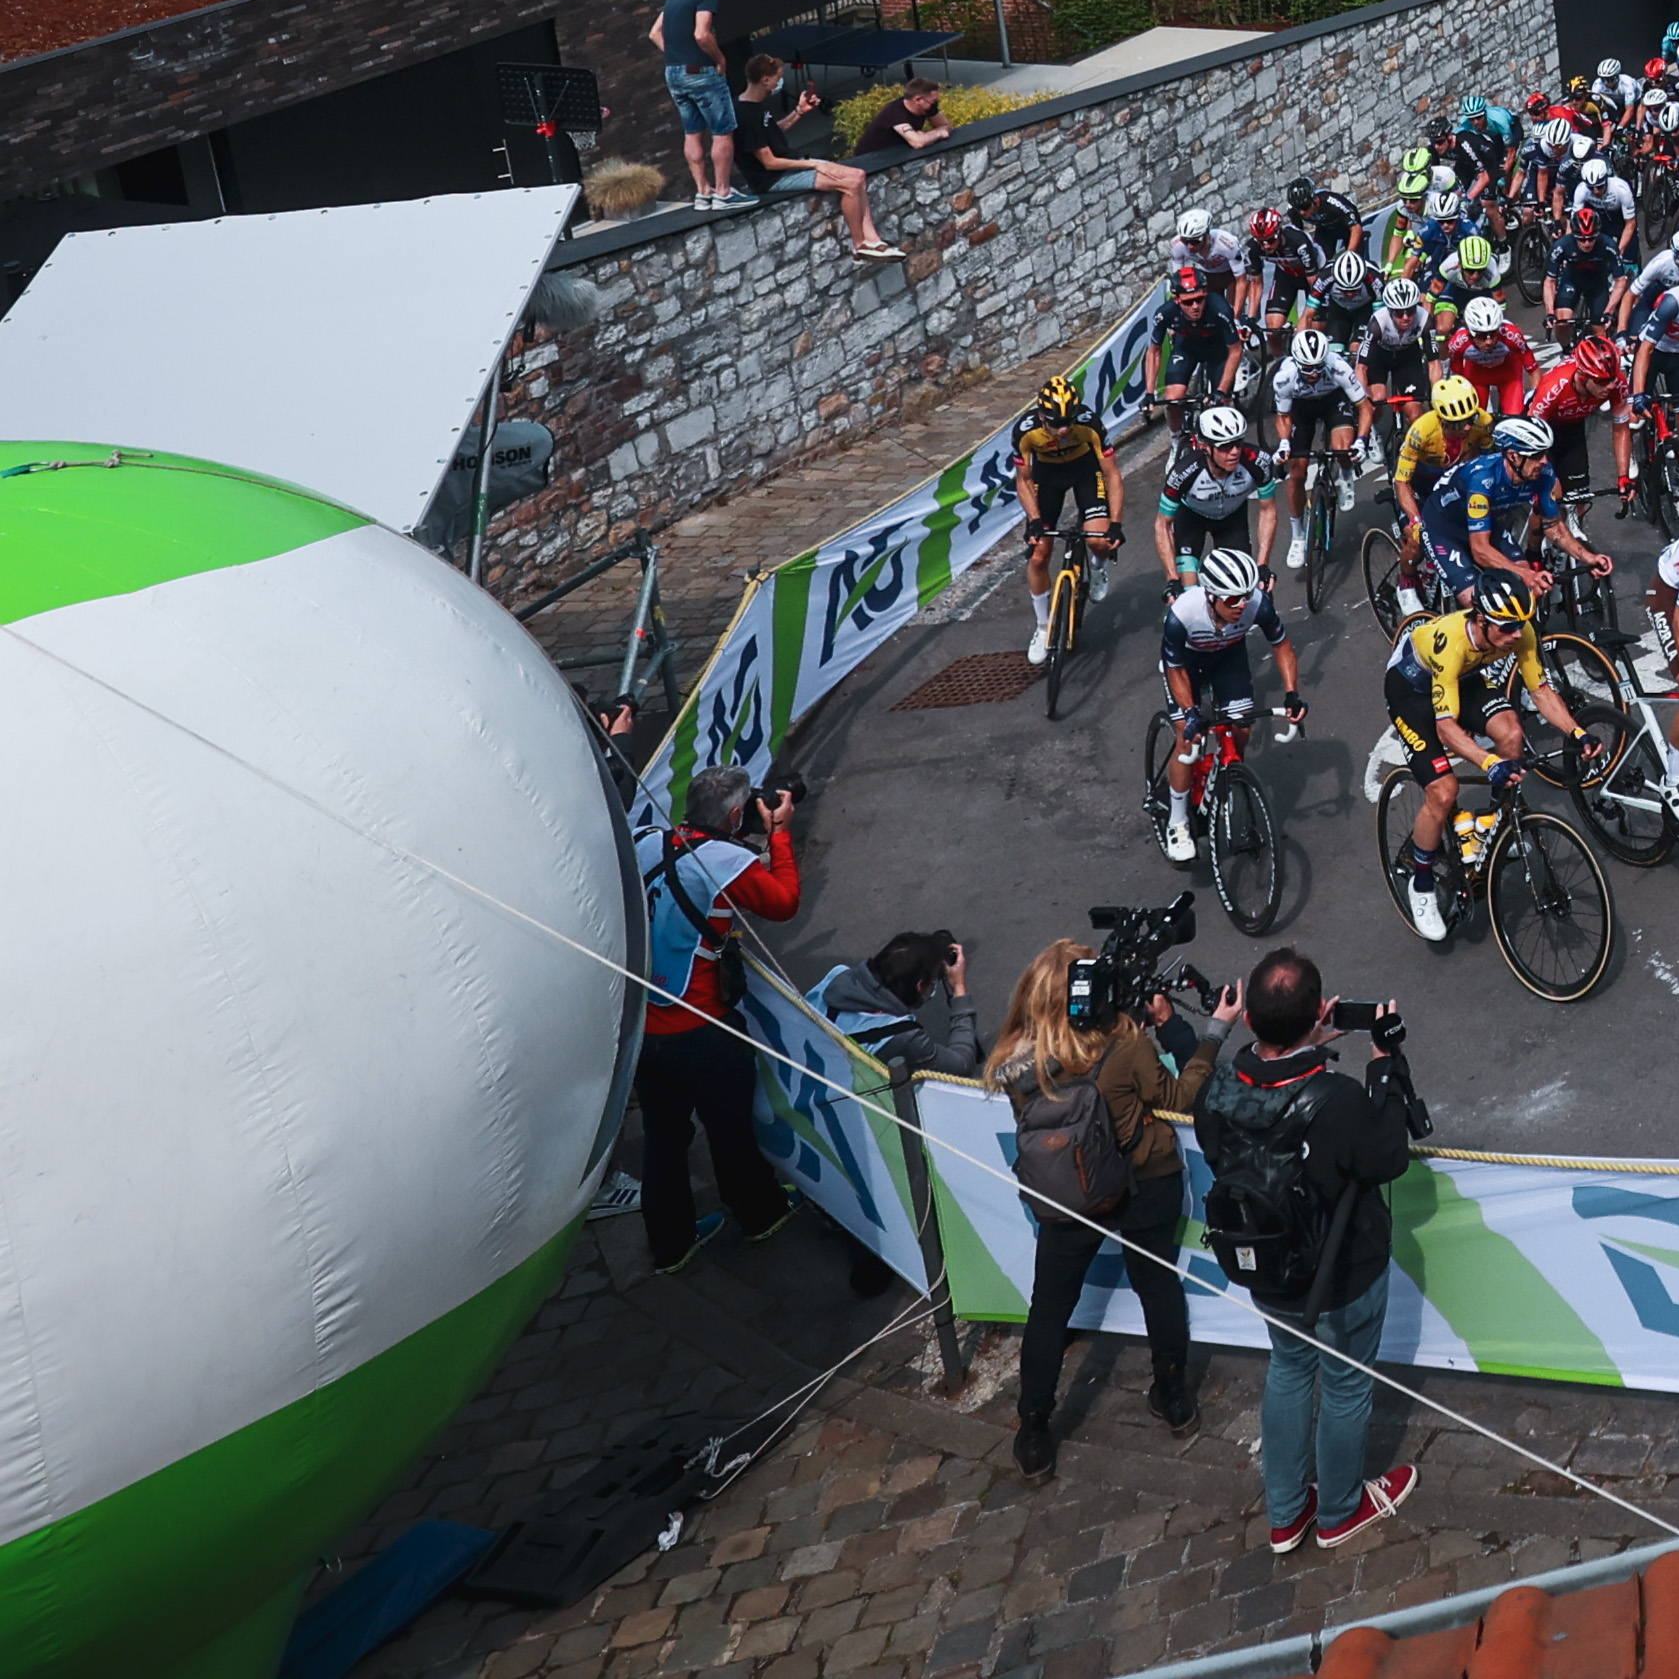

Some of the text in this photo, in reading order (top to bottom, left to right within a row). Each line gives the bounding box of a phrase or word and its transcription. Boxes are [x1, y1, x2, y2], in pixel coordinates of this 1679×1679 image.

[1652, 610, 1678, 663] AG2R LA
[1394, 715, 1427, 753] JUMBO
